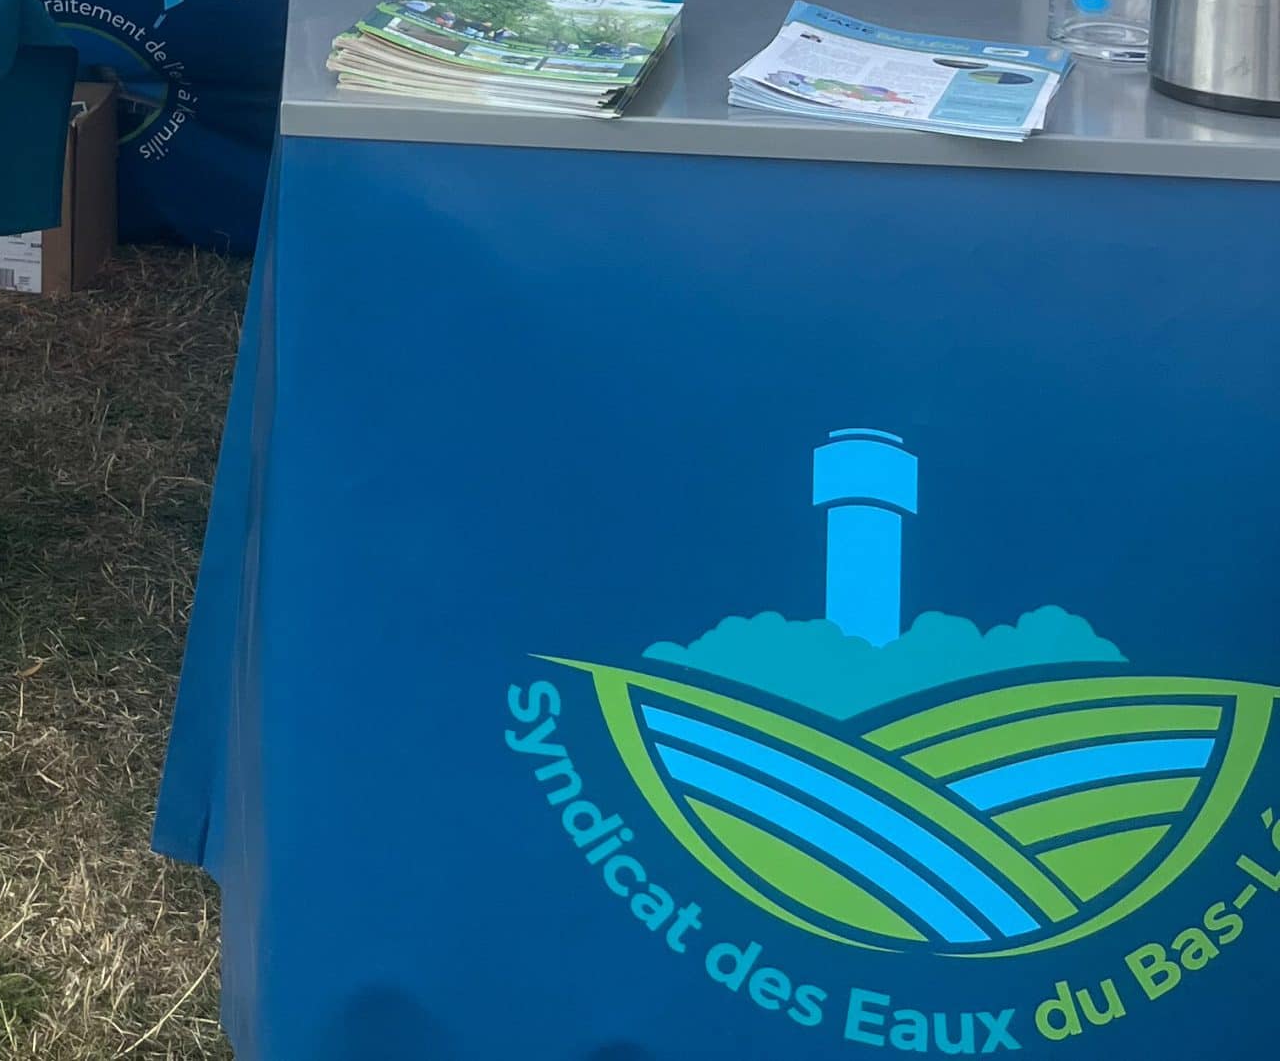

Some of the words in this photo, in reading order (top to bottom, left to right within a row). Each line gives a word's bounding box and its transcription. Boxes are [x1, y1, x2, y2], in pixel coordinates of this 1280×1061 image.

[144, 41, 167, 62] de
[505, 679, 703, 953] Syndicat
[704, 939, 828, 1027] des
[844, 987, 1023, 1055] Eaux
[1034, 980, 1126, 1040] du
